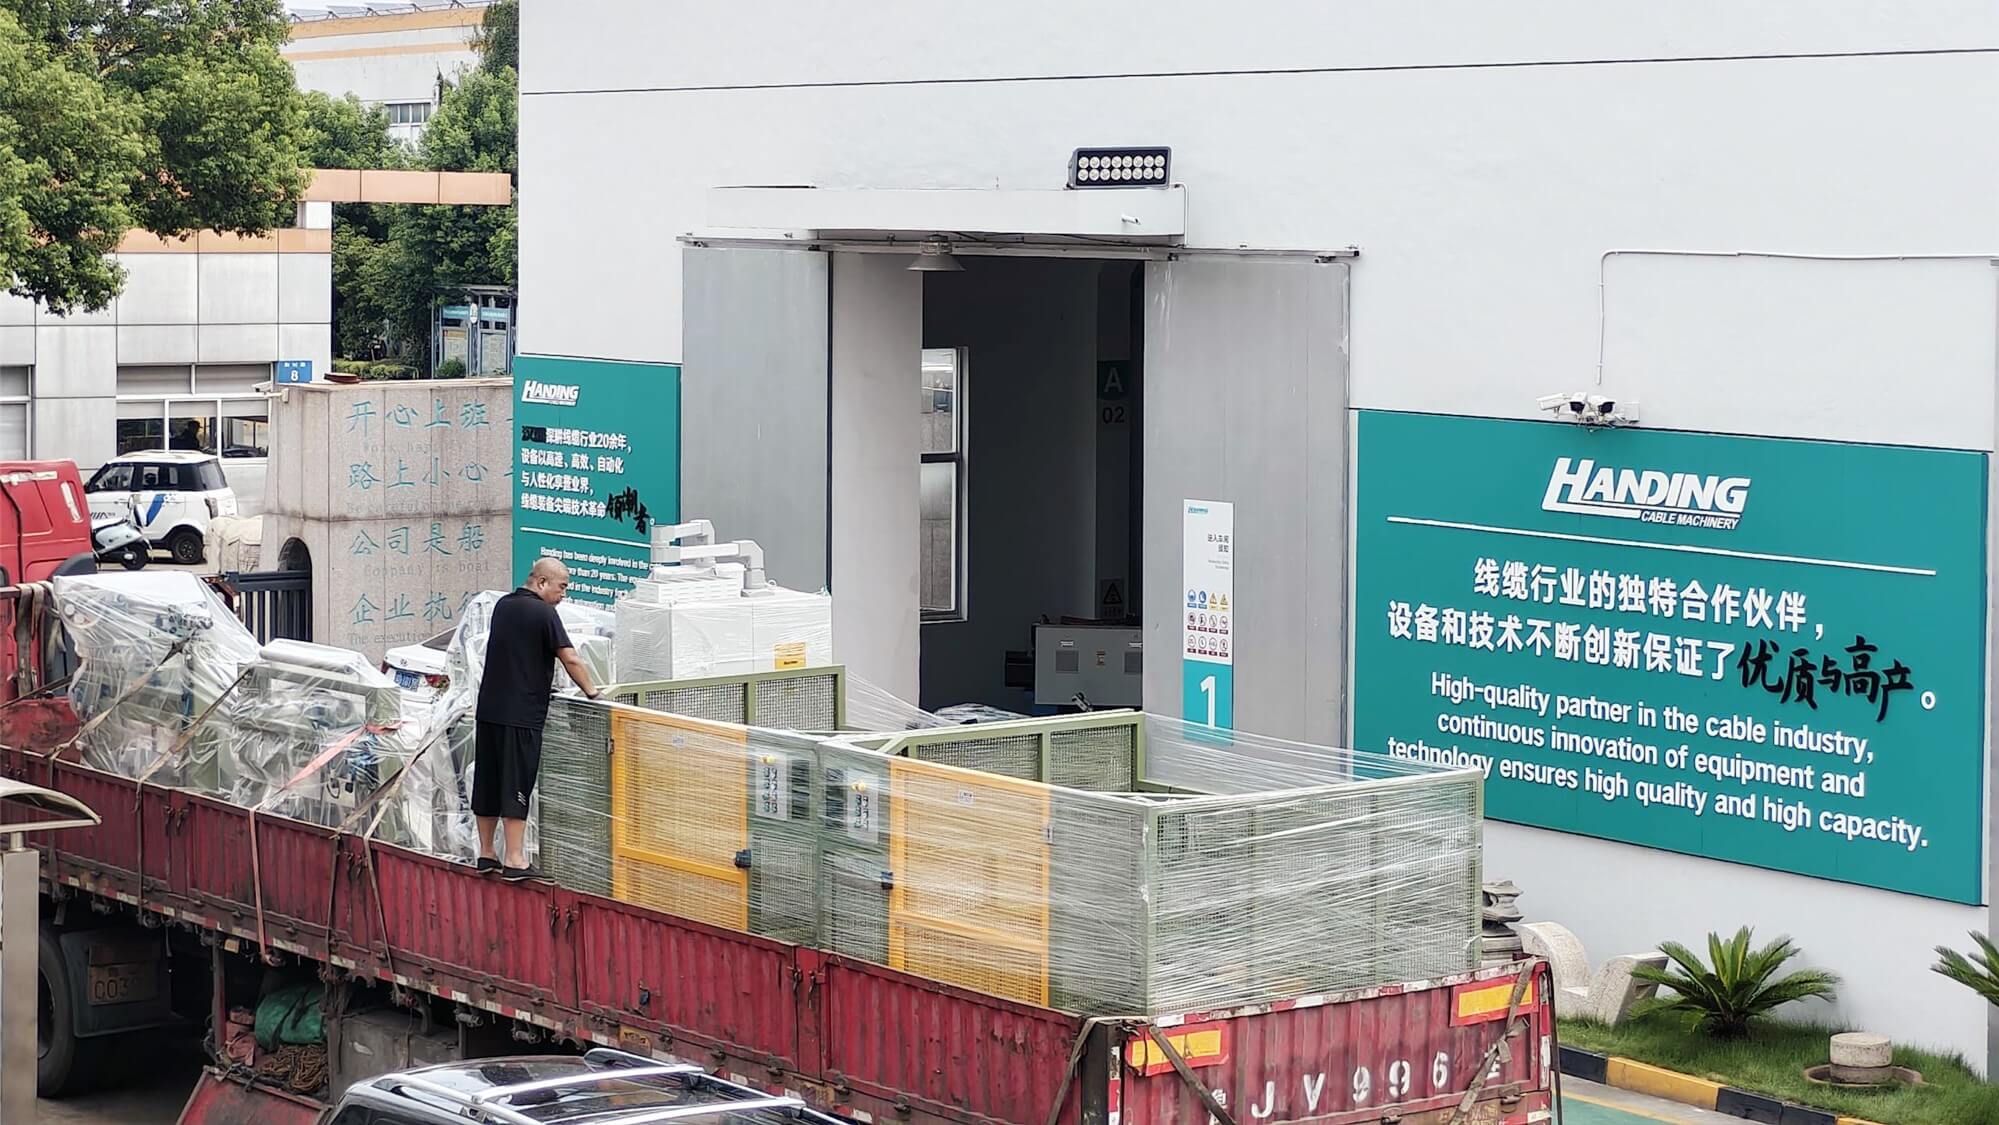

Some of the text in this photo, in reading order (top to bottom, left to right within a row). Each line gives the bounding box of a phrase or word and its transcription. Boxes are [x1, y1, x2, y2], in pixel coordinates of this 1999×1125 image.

[291, 370, 299, 381] 8
[521, 380, 580, 403] HANDING
[1104, 367, 1124, 393] A
[1102, 406, 1125, 424] 02
[1542, 457, 1751, 513] HANDING
[351, 522, 486, 556] 公司是船
[1641, 510, 1740, 530] CABLE MACHINERY
[1473, 556, 1823, 640] 线缆行业的独特合作伙伴，
[1387, 600, 1937, 722] 设备和技术不断创新保证了优质与高产。
[1200, 675, 1216, 729] 1
[1431, 671, 1873, 764] High-quality partner in the cable industry,
[1437, 713, 1865, 798] continuous innovation of equipment and
[1388, 737, 1928, 852] technology ensures high quality and high capacity.
